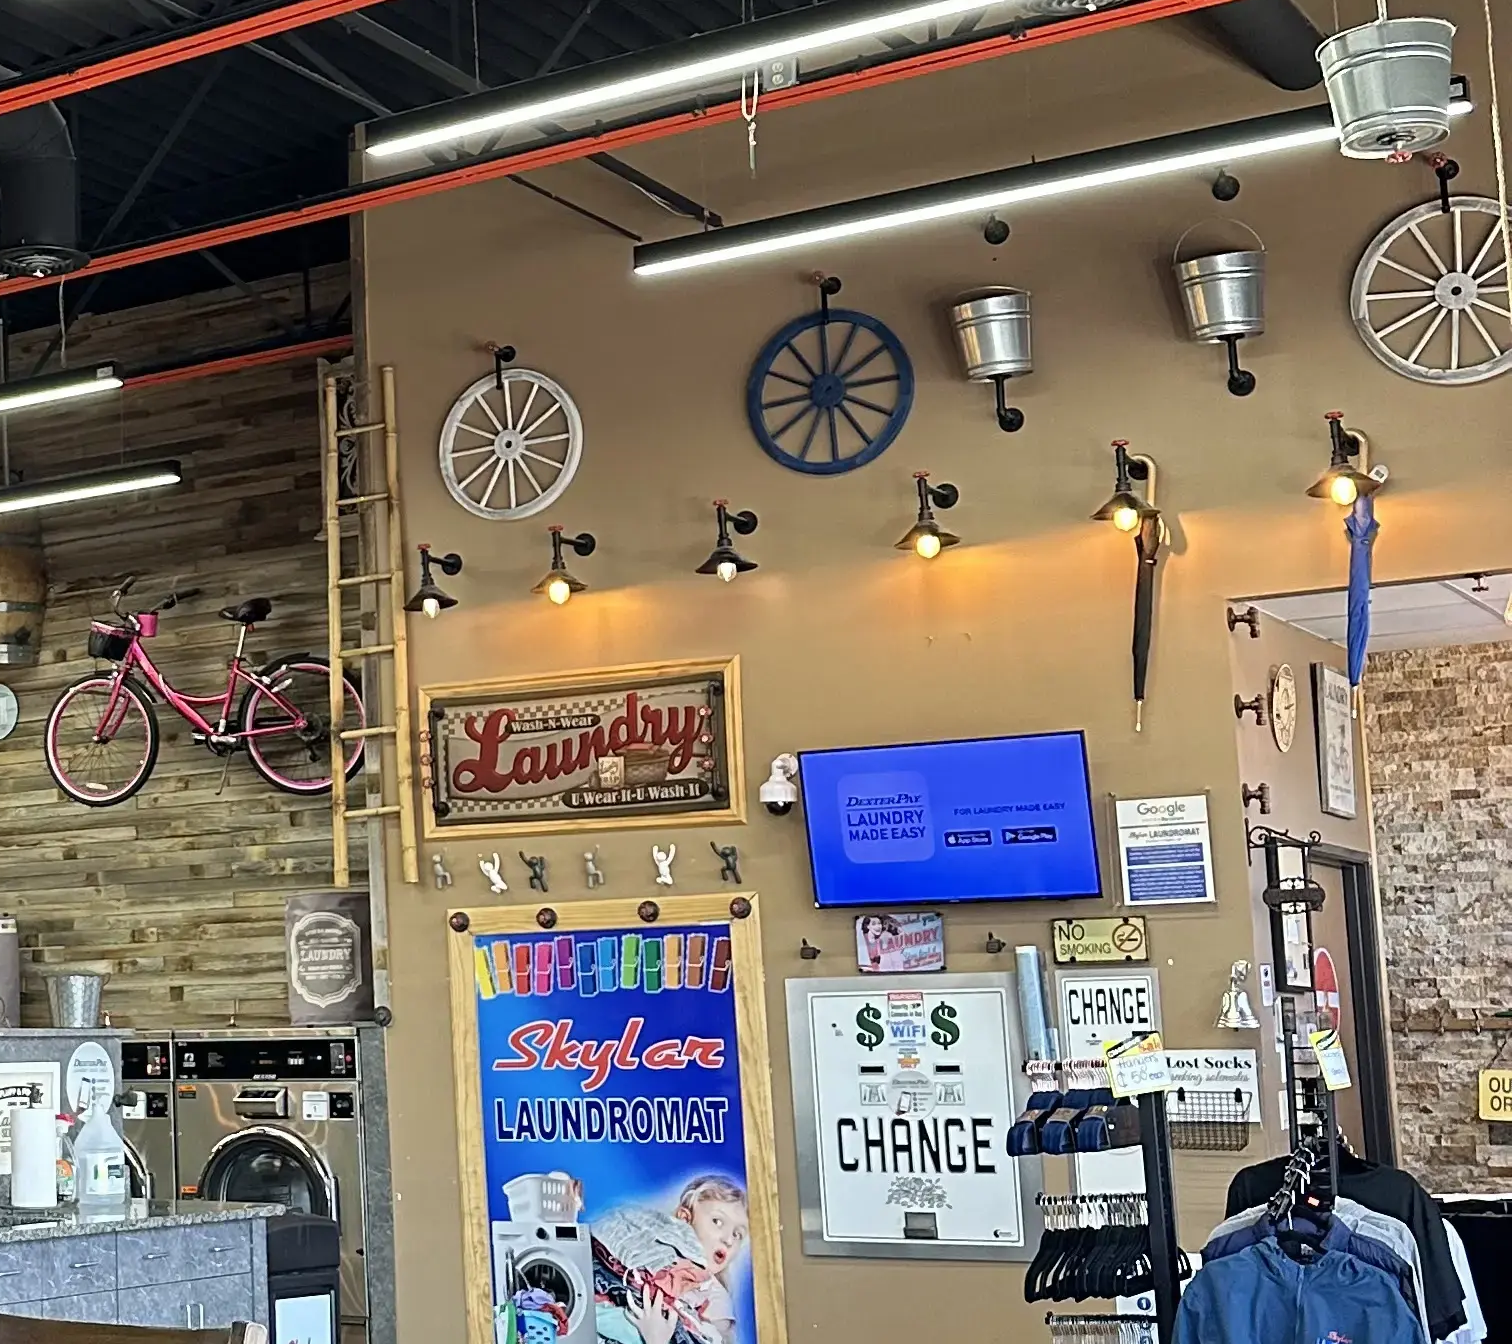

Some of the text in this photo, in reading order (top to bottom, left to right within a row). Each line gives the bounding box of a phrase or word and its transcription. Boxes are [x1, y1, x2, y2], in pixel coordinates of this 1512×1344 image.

[510, 713, 594, 734] Wash-N-Wear
[452, 692, 706, 794] Laundry
[954, 802, 1066, 817] FOR LAUNDRY MADE EASY
[1136, 801, 1186, 817] Google
[847, 809, 925, 828] LAUNDRY
[849, 825, 927, 843] MADE EASY
[957, 834, 989, 845] App Store
[1017, 831, 1054, 842] Google Play
[1149, 828, 1200, 839] LAUNDROMAT
[1058, 924, 1085, 941] NO
[300, 948, 352, 962] LAUNDRY
[1060, 942, 1112, 956] SMOKING
[1068, 987, 1149, 1025] CHANGE
[492, 1018, 725, 1092] Skylar
[1166, 1055, 1252, 1069] Lost Socks
[494, 1097, 729, 1143] LAUNDROMAT
[837, 1117, 996, 1174] CHANGE
